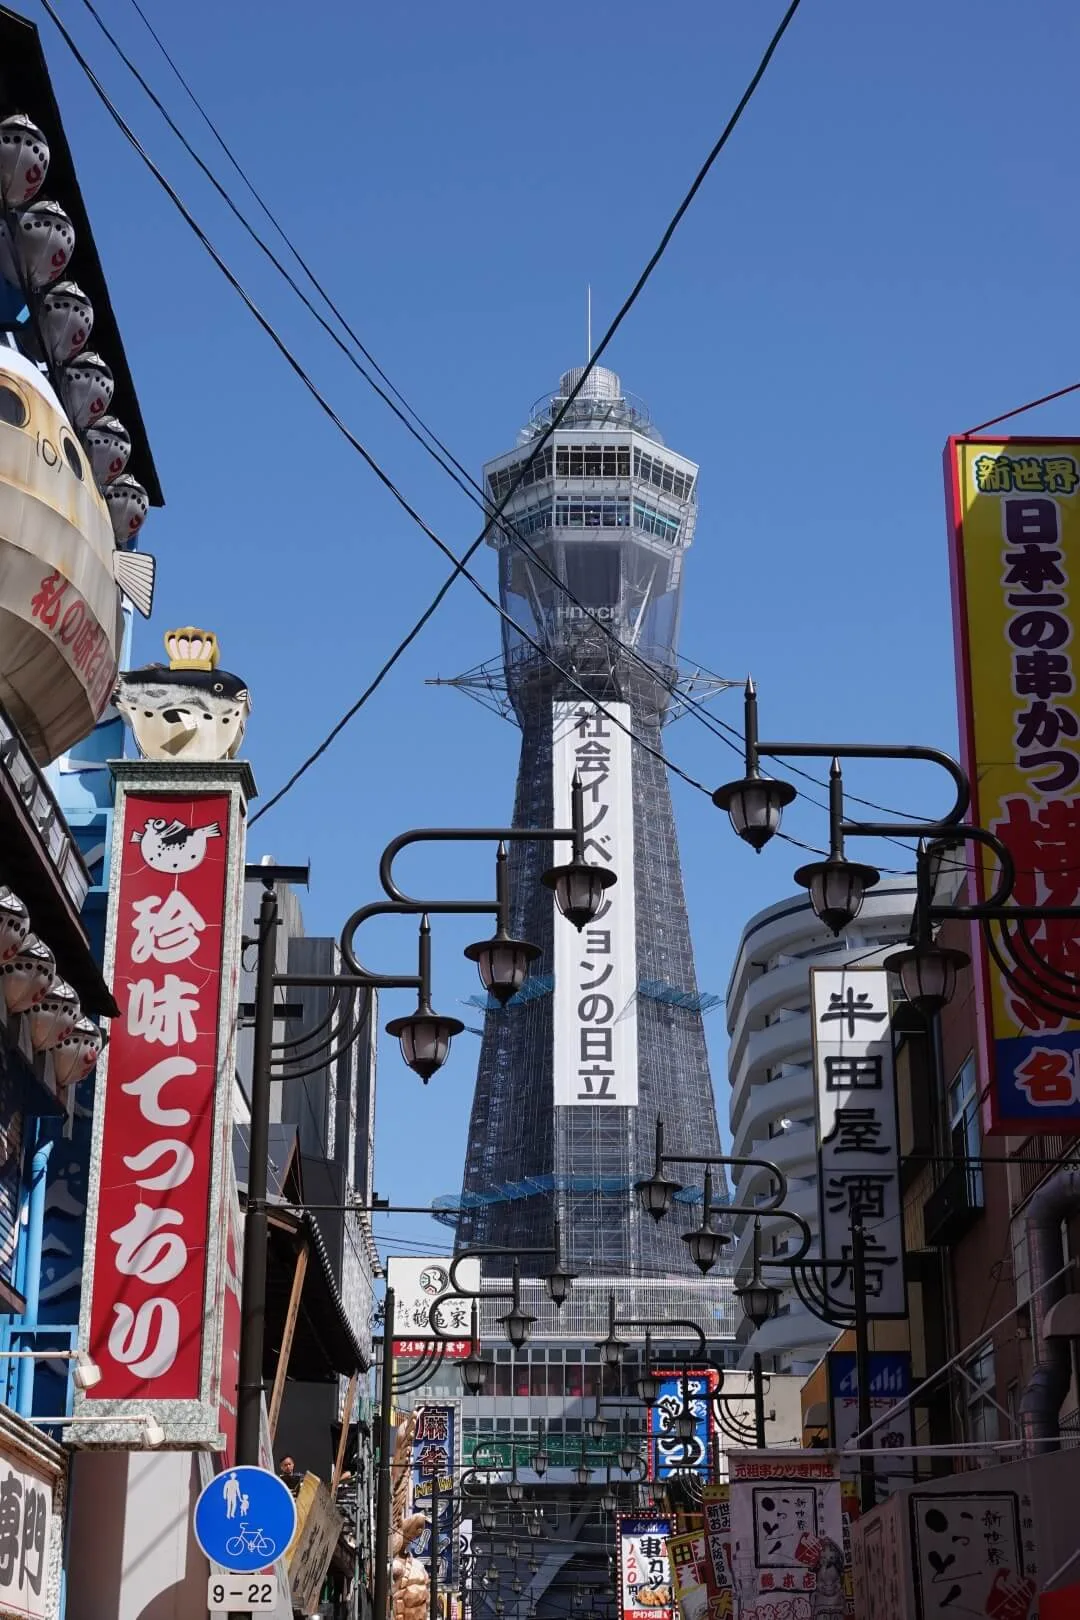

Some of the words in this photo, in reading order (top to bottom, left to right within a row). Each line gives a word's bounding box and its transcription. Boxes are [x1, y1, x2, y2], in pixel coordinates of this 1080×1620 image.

[975, 457, 1078, 493] 新世界
[1004, 500, 1079, 791] 日本一の串かつ
[574, 706, 617, 1100] 社会イノベョンの日立
[839, 1366, 903, 1391] Aahi
[734, 1463, 834, 1478] 元祖串カツ専門店
[639, 1536, 664, 1590] 串カツ
